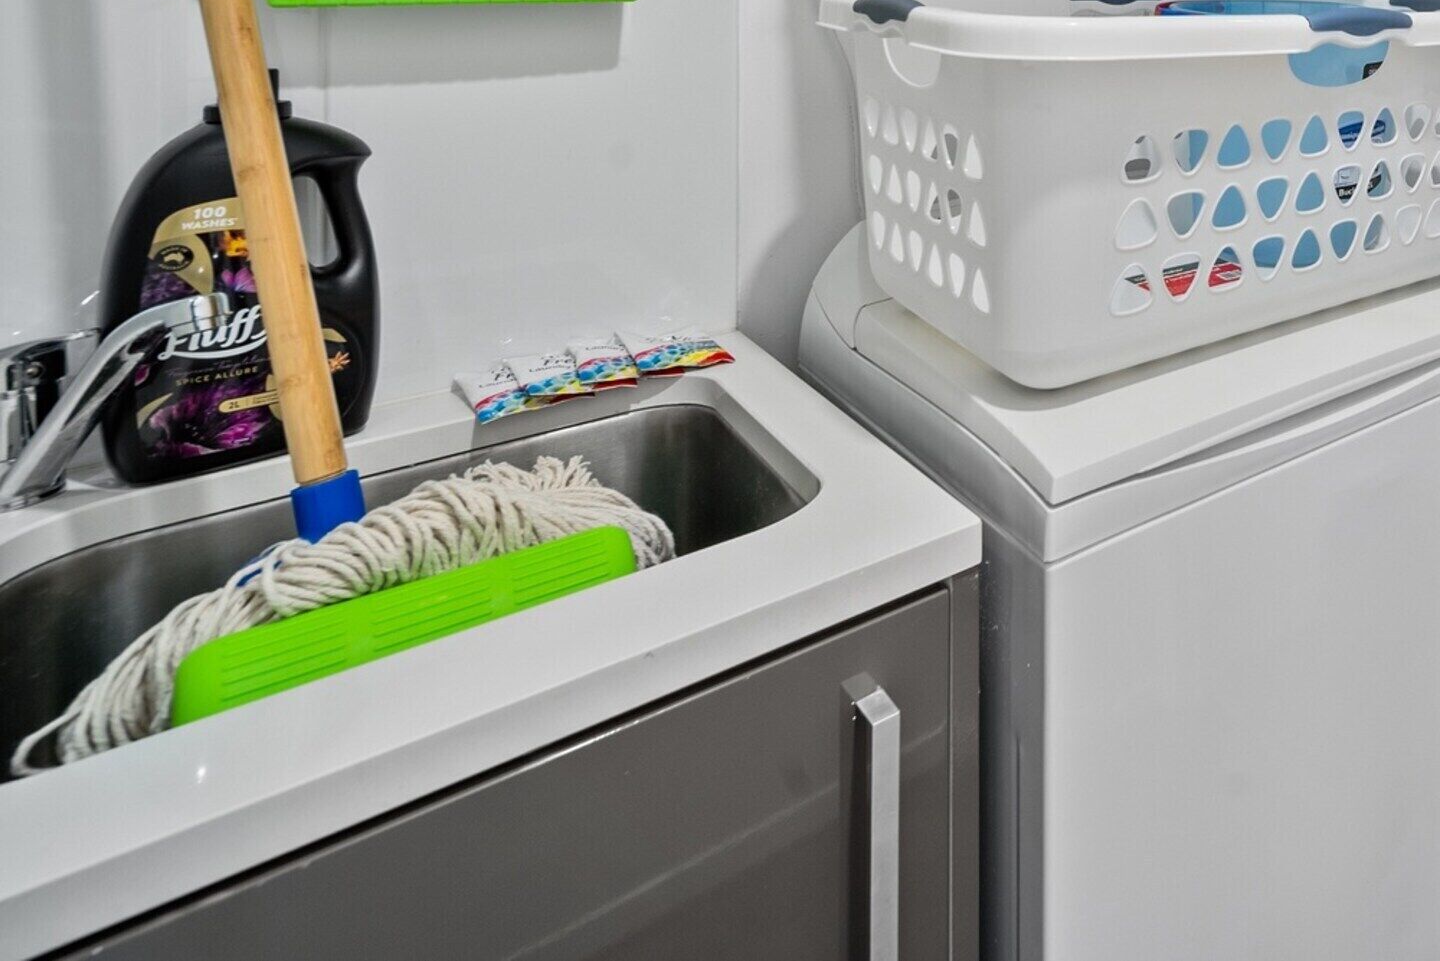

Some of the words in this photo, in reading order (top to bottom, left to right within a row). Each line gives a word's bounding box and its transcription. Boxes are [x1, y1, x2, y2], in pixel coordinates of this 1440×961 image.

[194, 206, 227, 220] 100
[176, 374, 210, 386] SPICE
[215, 366, 258, 380] ALLURE
